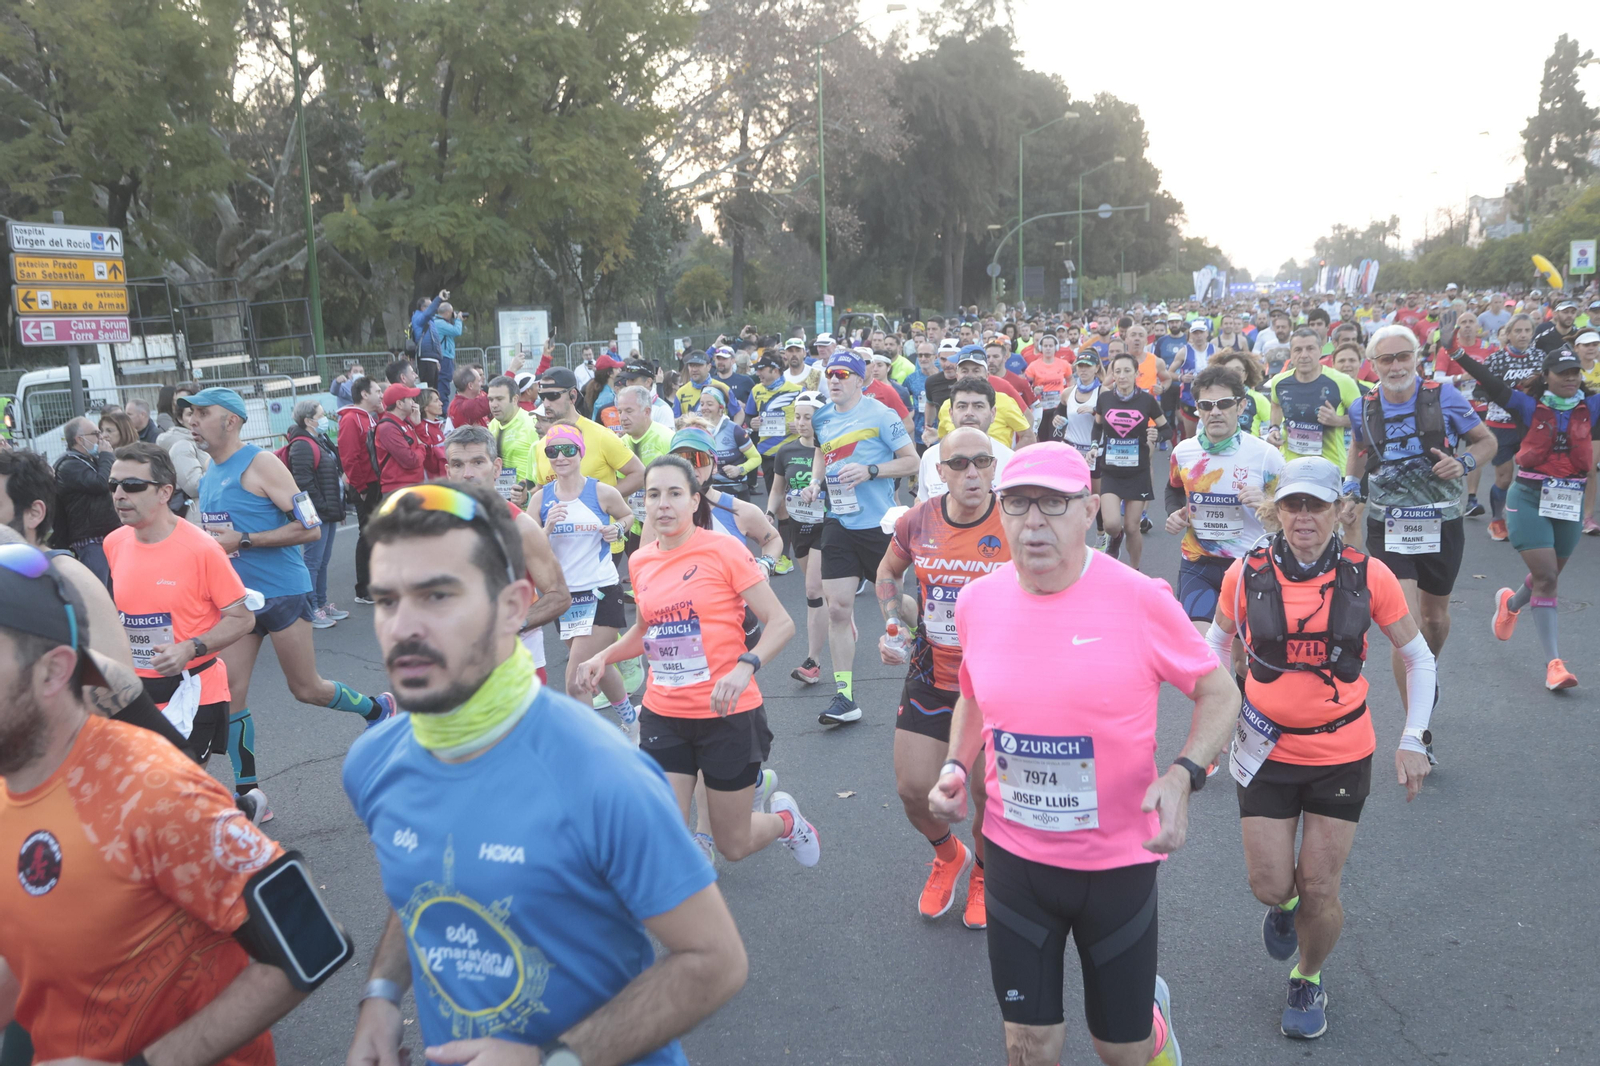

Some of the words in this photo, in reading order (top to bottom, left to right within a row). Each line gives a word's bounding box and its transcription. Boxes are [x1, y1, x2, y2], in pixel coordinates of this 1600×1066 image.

[14, 227, 45, 237] hospital
[15, 236, 46, 249] Virgen
[49, 239, 63, 248] del
[18, 259, 49, 269] estación
[53, 260, 78, 270] Prado
[19, 269, 37, 279] San
[96, 290, 125, 299] estación
[54, 300, 78, 310] Plaza
[82, 300, 94, 310] de
[98, 301, 125, 310] Armas
[70, 319, 97, 331] Caixa
[100, 320, 127, 330] Forum
[69, 330, 94, 341] Torre
[98, 330, 128, 341] Sevilla
[1204, 496, 1235, 504] ZURICH
[1206, 510, 1224, 518] 7759
[575, 524, 598, 532] PLUS
[1404, 524, 1422, 532] 9948
[126, 616, 163, 626] ZURICH
[658, 624, 692, 636] ZURICH
[130, 634, 150, 644] 8098
[662, 662, 685, 670] ISABEL
[1242, 702, 1274, 736] ZURICH
[1020, 740, 1080, 755] ZURICH
[1024, 770, 1058, 786] 7974
[1012, 790, 1042, 806] JOSEP
[1046, 794, 1080, 808] LLUÍS
[393, 828, 418, 853] edp
[478, 843, 526, 864] HOKA
[446, 923, 479, 948] edp
[442, 946, 502, 965] maratón
